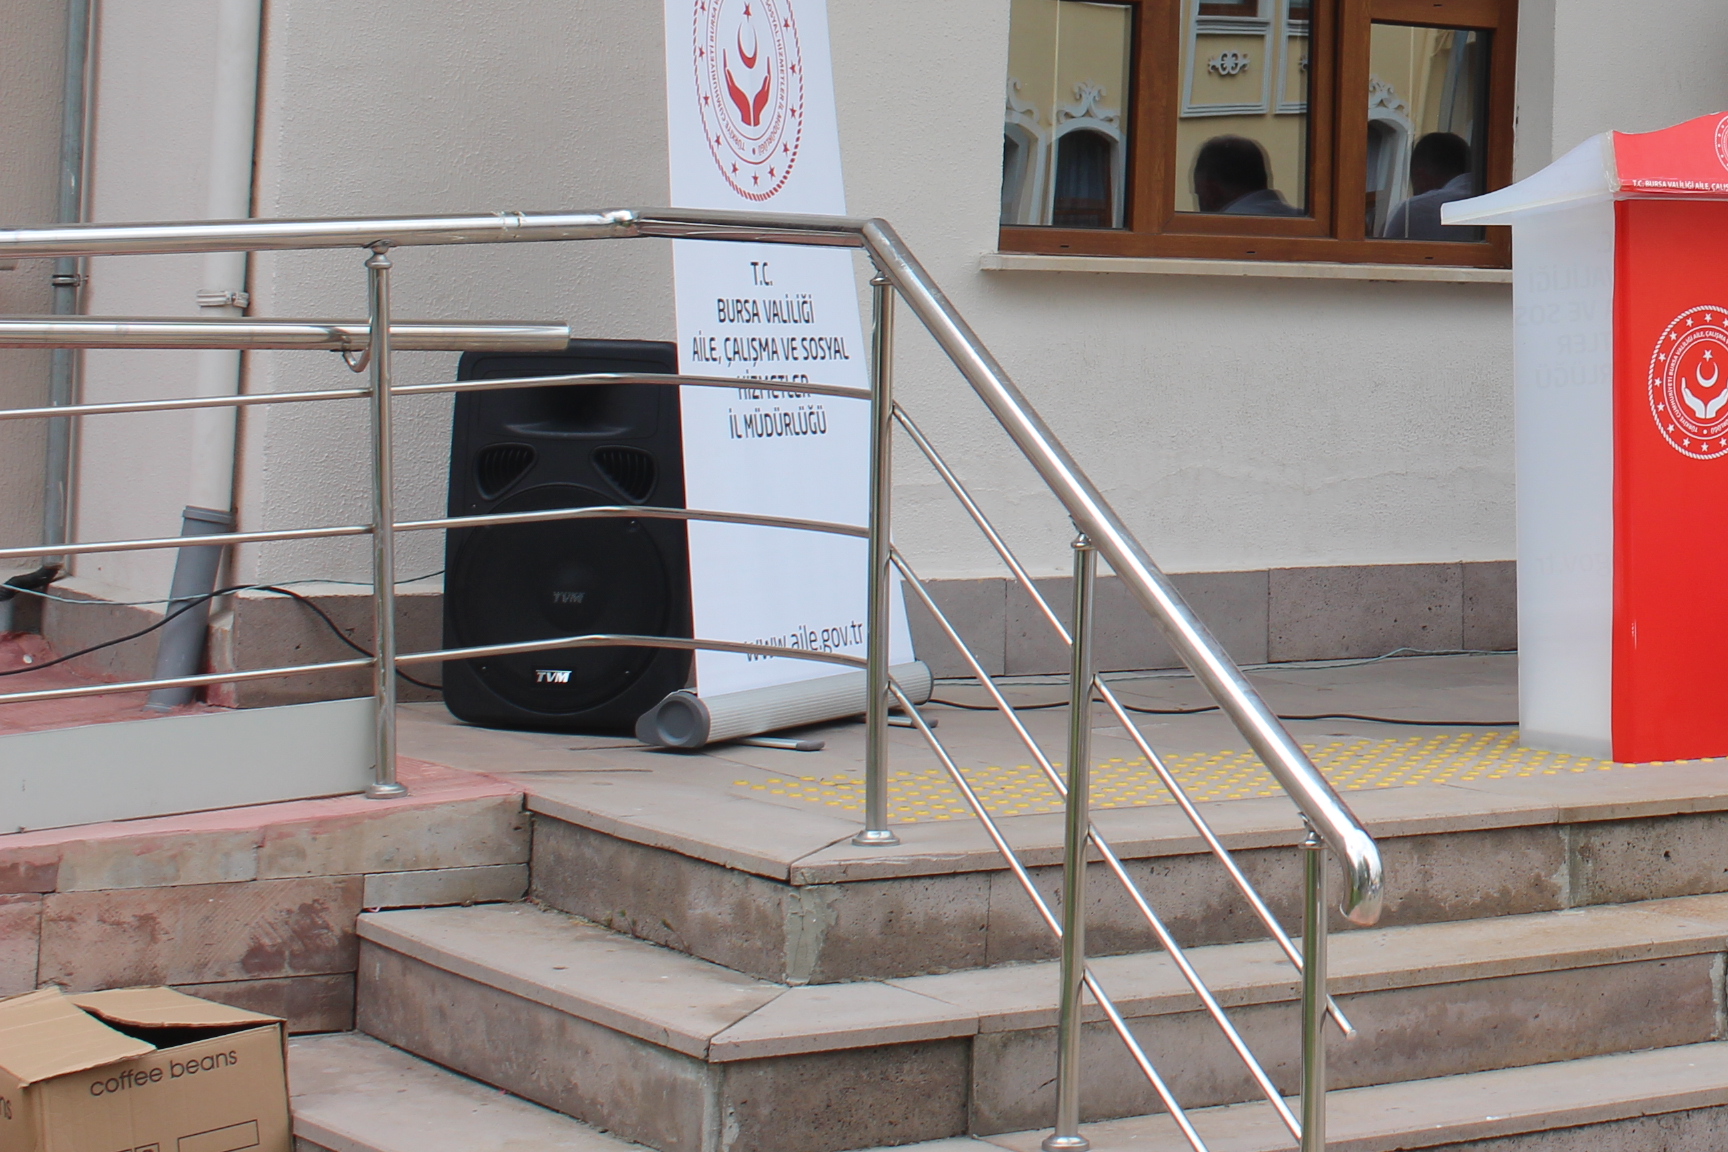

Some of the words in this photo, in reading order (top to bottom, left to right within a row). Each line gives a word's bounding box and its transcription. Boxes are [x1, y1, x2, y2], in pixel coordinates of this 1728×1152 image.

[750, 261, 773, 286] T.C.
[717, 298, 761, 323] BURSA
[762, 293, 815, 324] VALİLİĞİ
[692, 330, 722, 365] AİLE,
[724, 336, 780, 367] ÇALIŞMA
[780, 337, 802, 361] VE
[802, 336, 850, 360] SOSYAL
[728, 408, 742, 439] İL
[744, 405, 827, 439] MÜDÜRLÜĞÜ
[553, 591, 585, 603] TVM
[744, 620, 862, 662] wwwaile.gov.tr
[535, 669, 572, 683] TVM
[90, 1068, 163, 1097] coffee
[170, 1049, 238, 1079] beans
